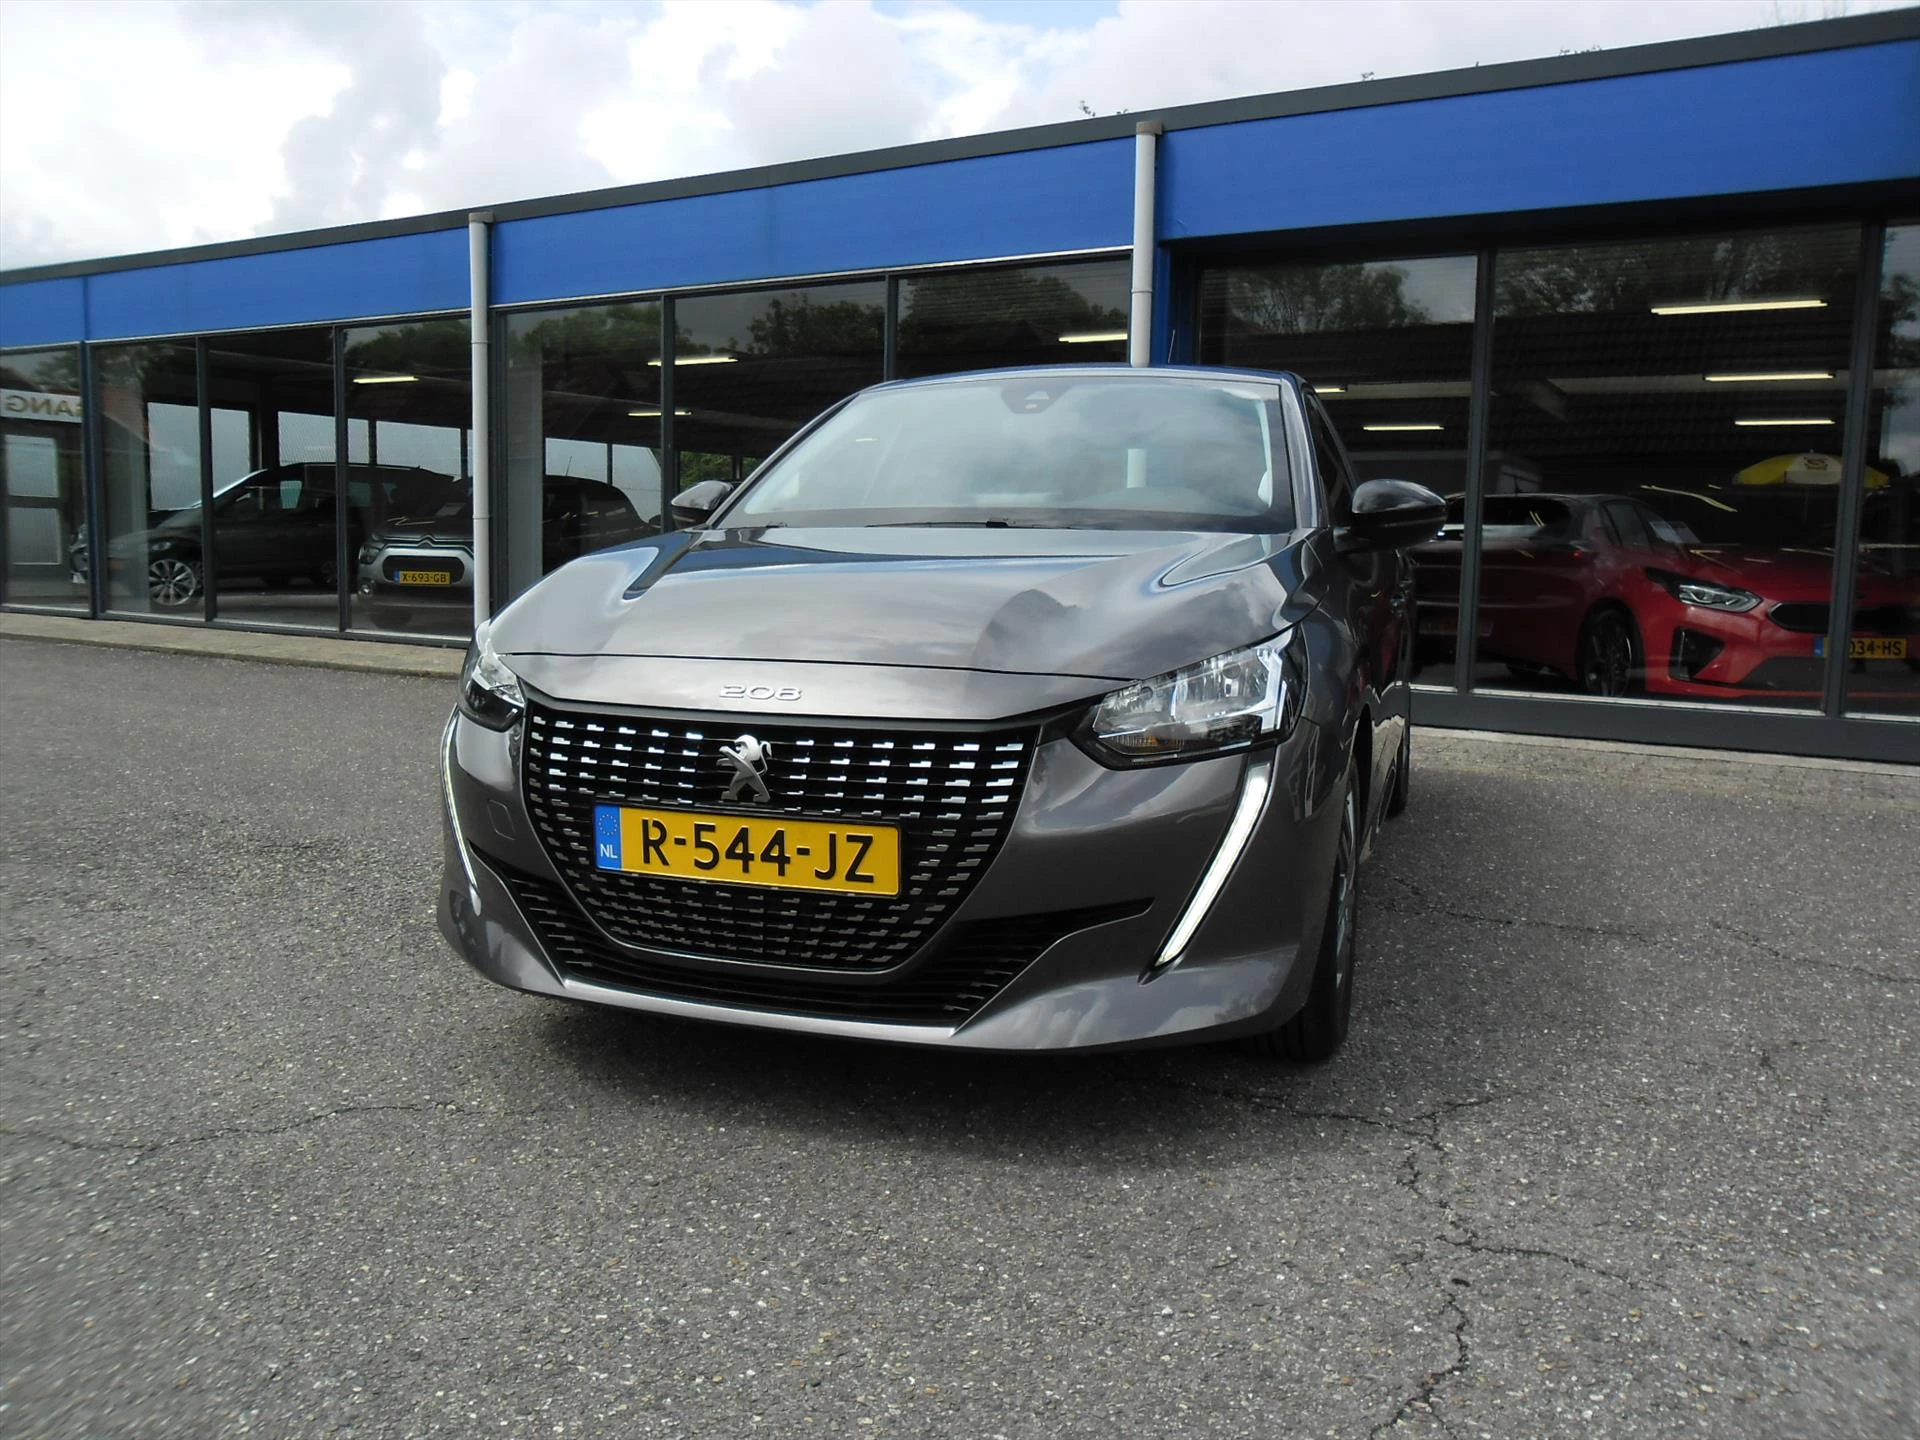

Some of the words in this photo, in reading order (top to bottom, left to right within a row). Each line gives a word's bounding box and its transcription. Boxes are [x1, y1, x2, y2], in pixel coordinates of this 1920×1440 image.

[402, 573, 447, 583] X-693-GB
[718, 684, 803, 702] 208
[600, 843, 618, 859] NL
[641, 817, 875, 884] R-544-JZ
